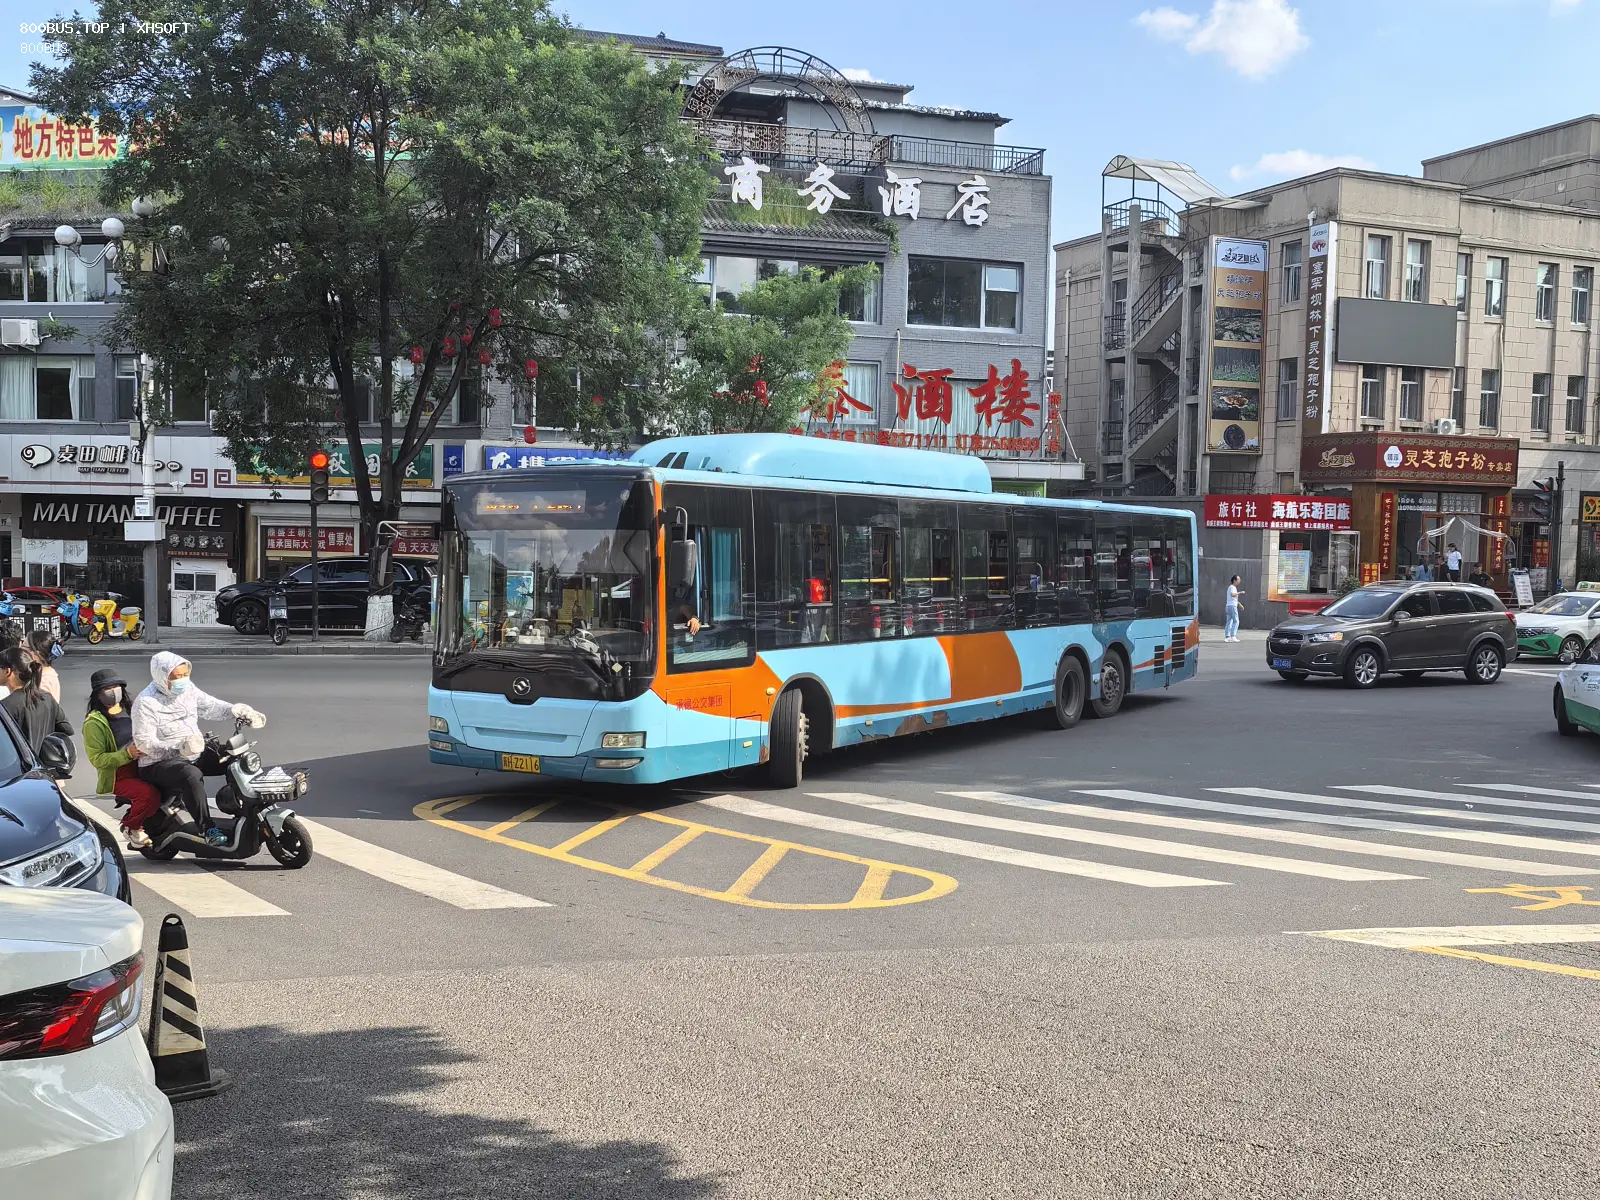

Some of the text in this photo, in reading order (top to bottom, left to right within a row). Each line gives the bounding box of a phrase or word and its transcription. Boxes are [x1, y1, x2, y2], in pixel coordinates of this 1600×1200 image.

[723, 156, 993, 228] 商务酒店
[1404, 448, 1487, 471] 灵芝孢子粉
[33, 502, 224, 527] MAI TIAN OFFEE
[1218, 501, 1258, 518] 旅行社
[1272, 500, 1351, 521] 海航乐游国旅
[266, 538, 326, 550] 隆承国际大戏
[327, 531, 354, 547] 售票处
